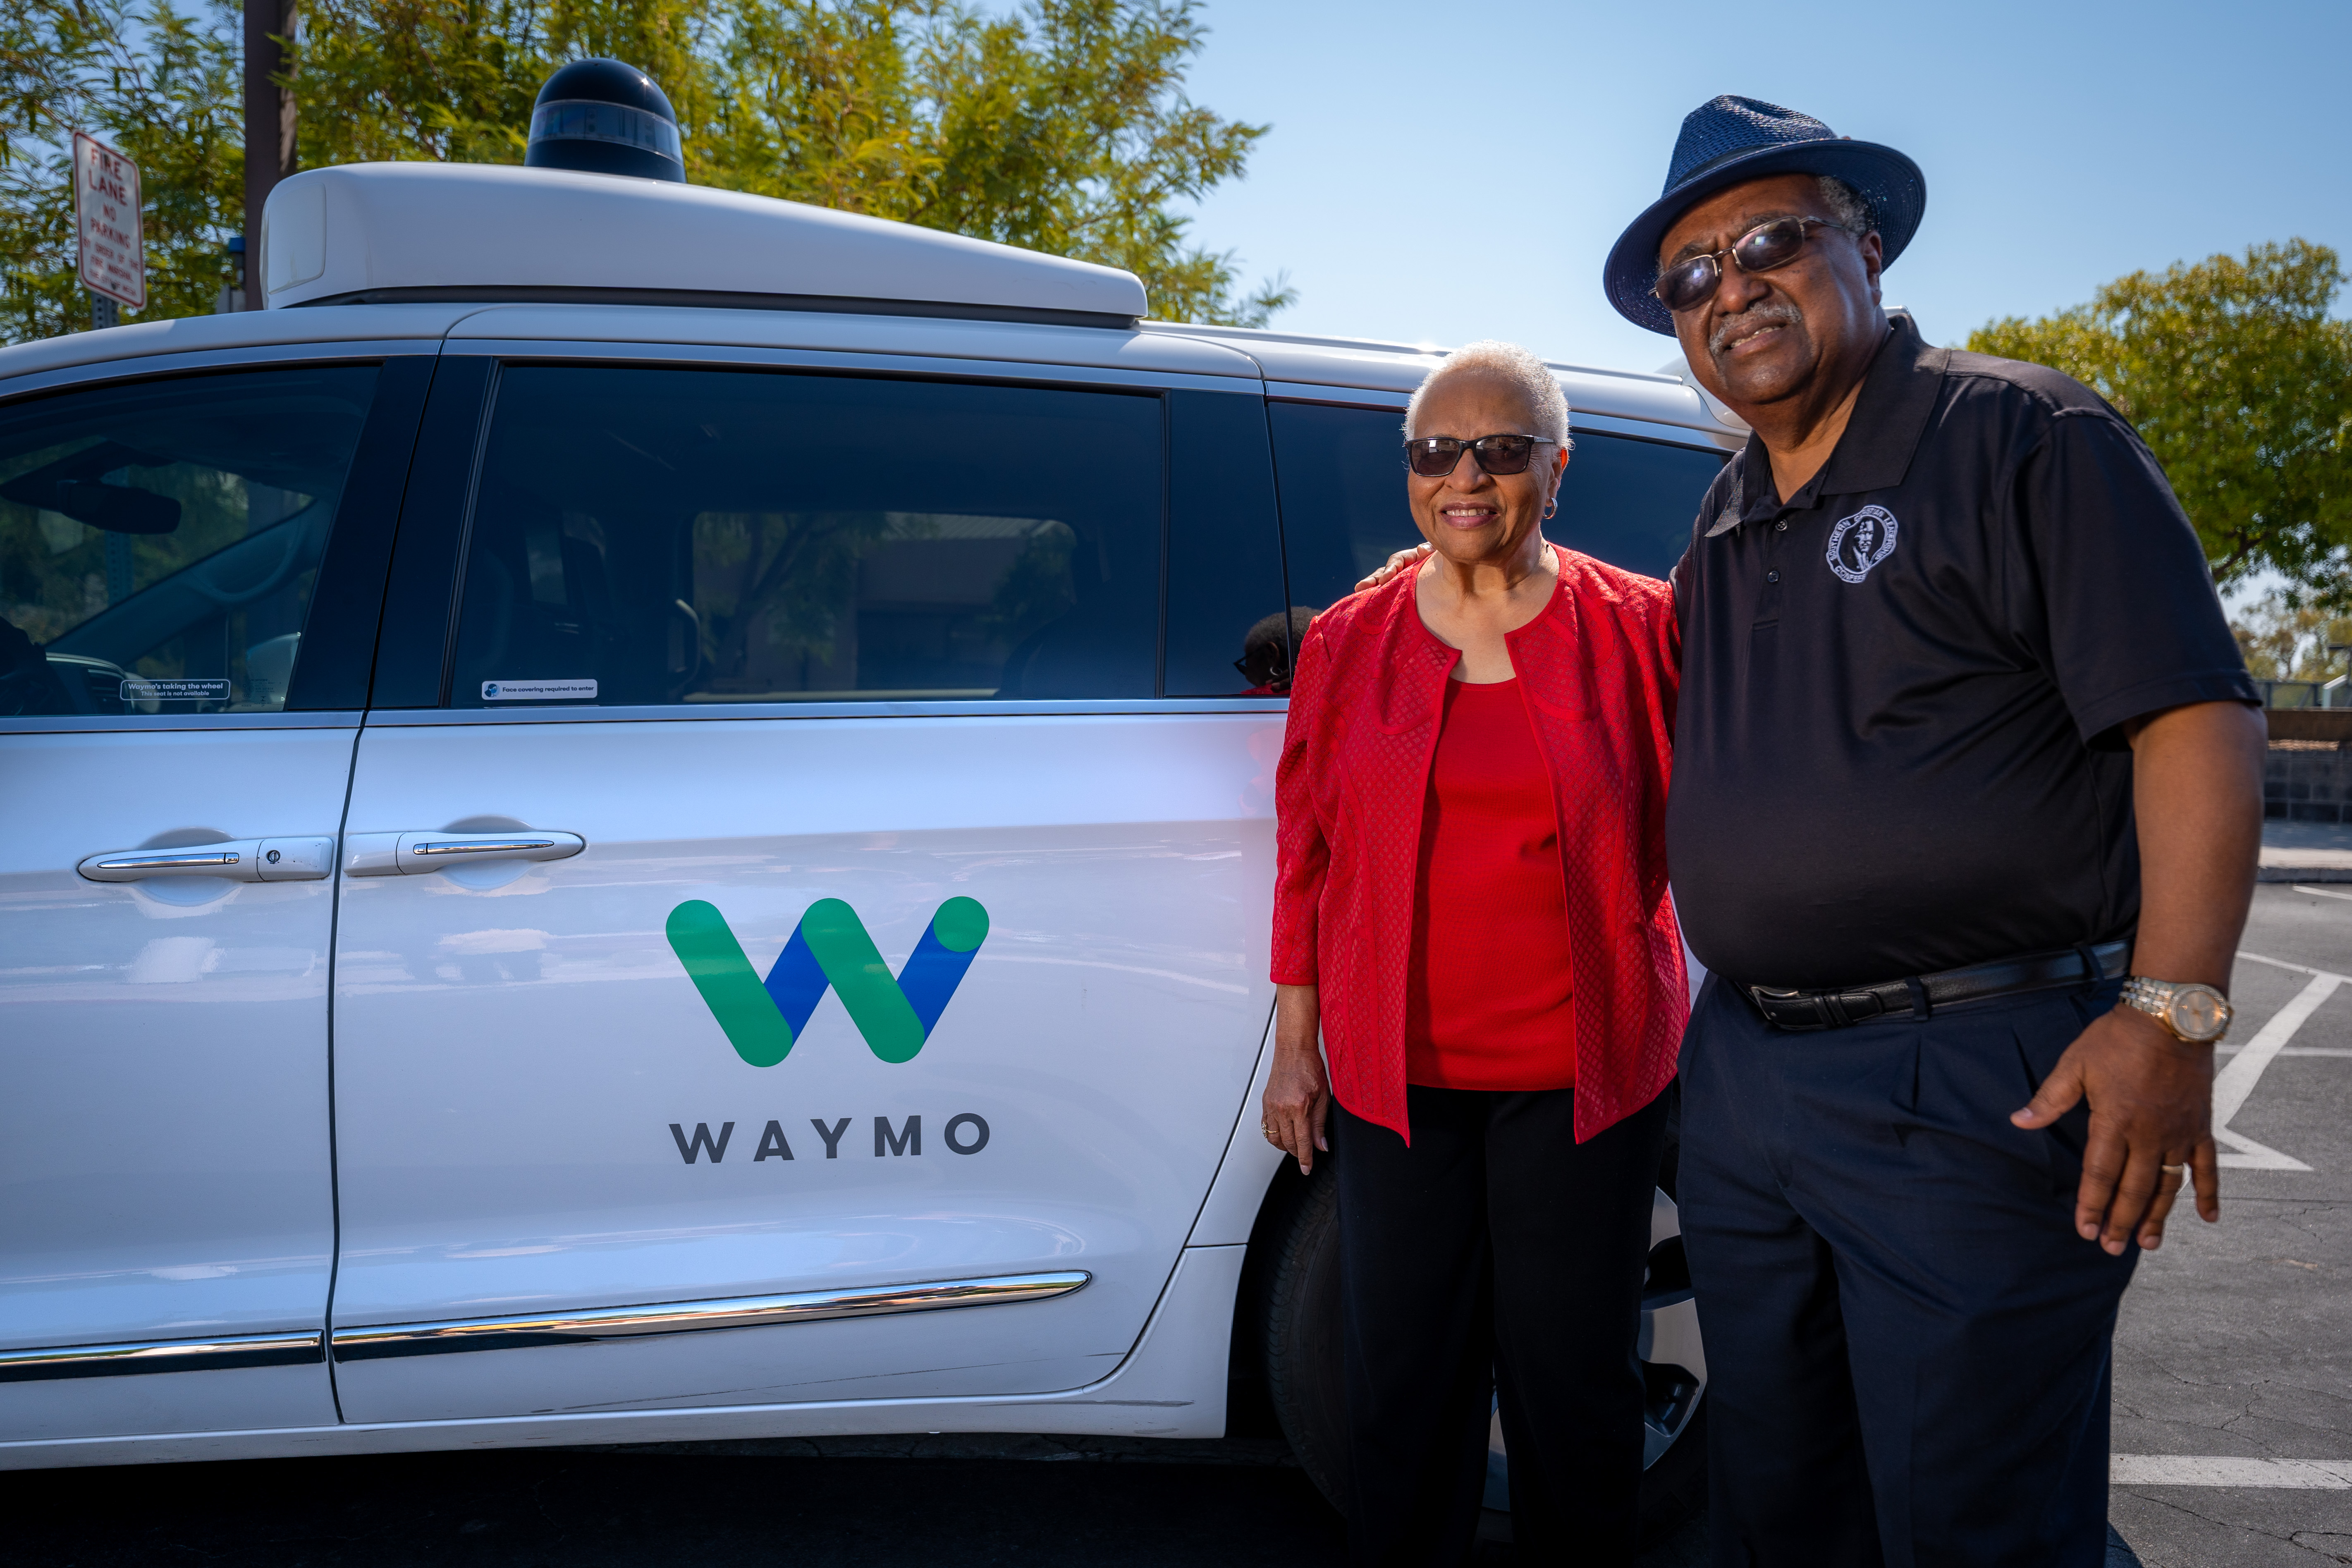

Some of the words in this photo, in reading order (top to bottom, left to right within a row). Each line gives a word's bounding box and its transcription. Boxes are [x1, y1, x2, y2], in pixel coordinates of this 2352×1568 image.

[91, 147, 122, 182] FIRE
[88, 168, 128, 207] LANE
[103, 202, 116, 222] NO
[90, 216, 130, 250] PARKING
[1829, 520, 1851, 561] SOUTHERN
[668, 1112, 990, 1164] WAYMO
